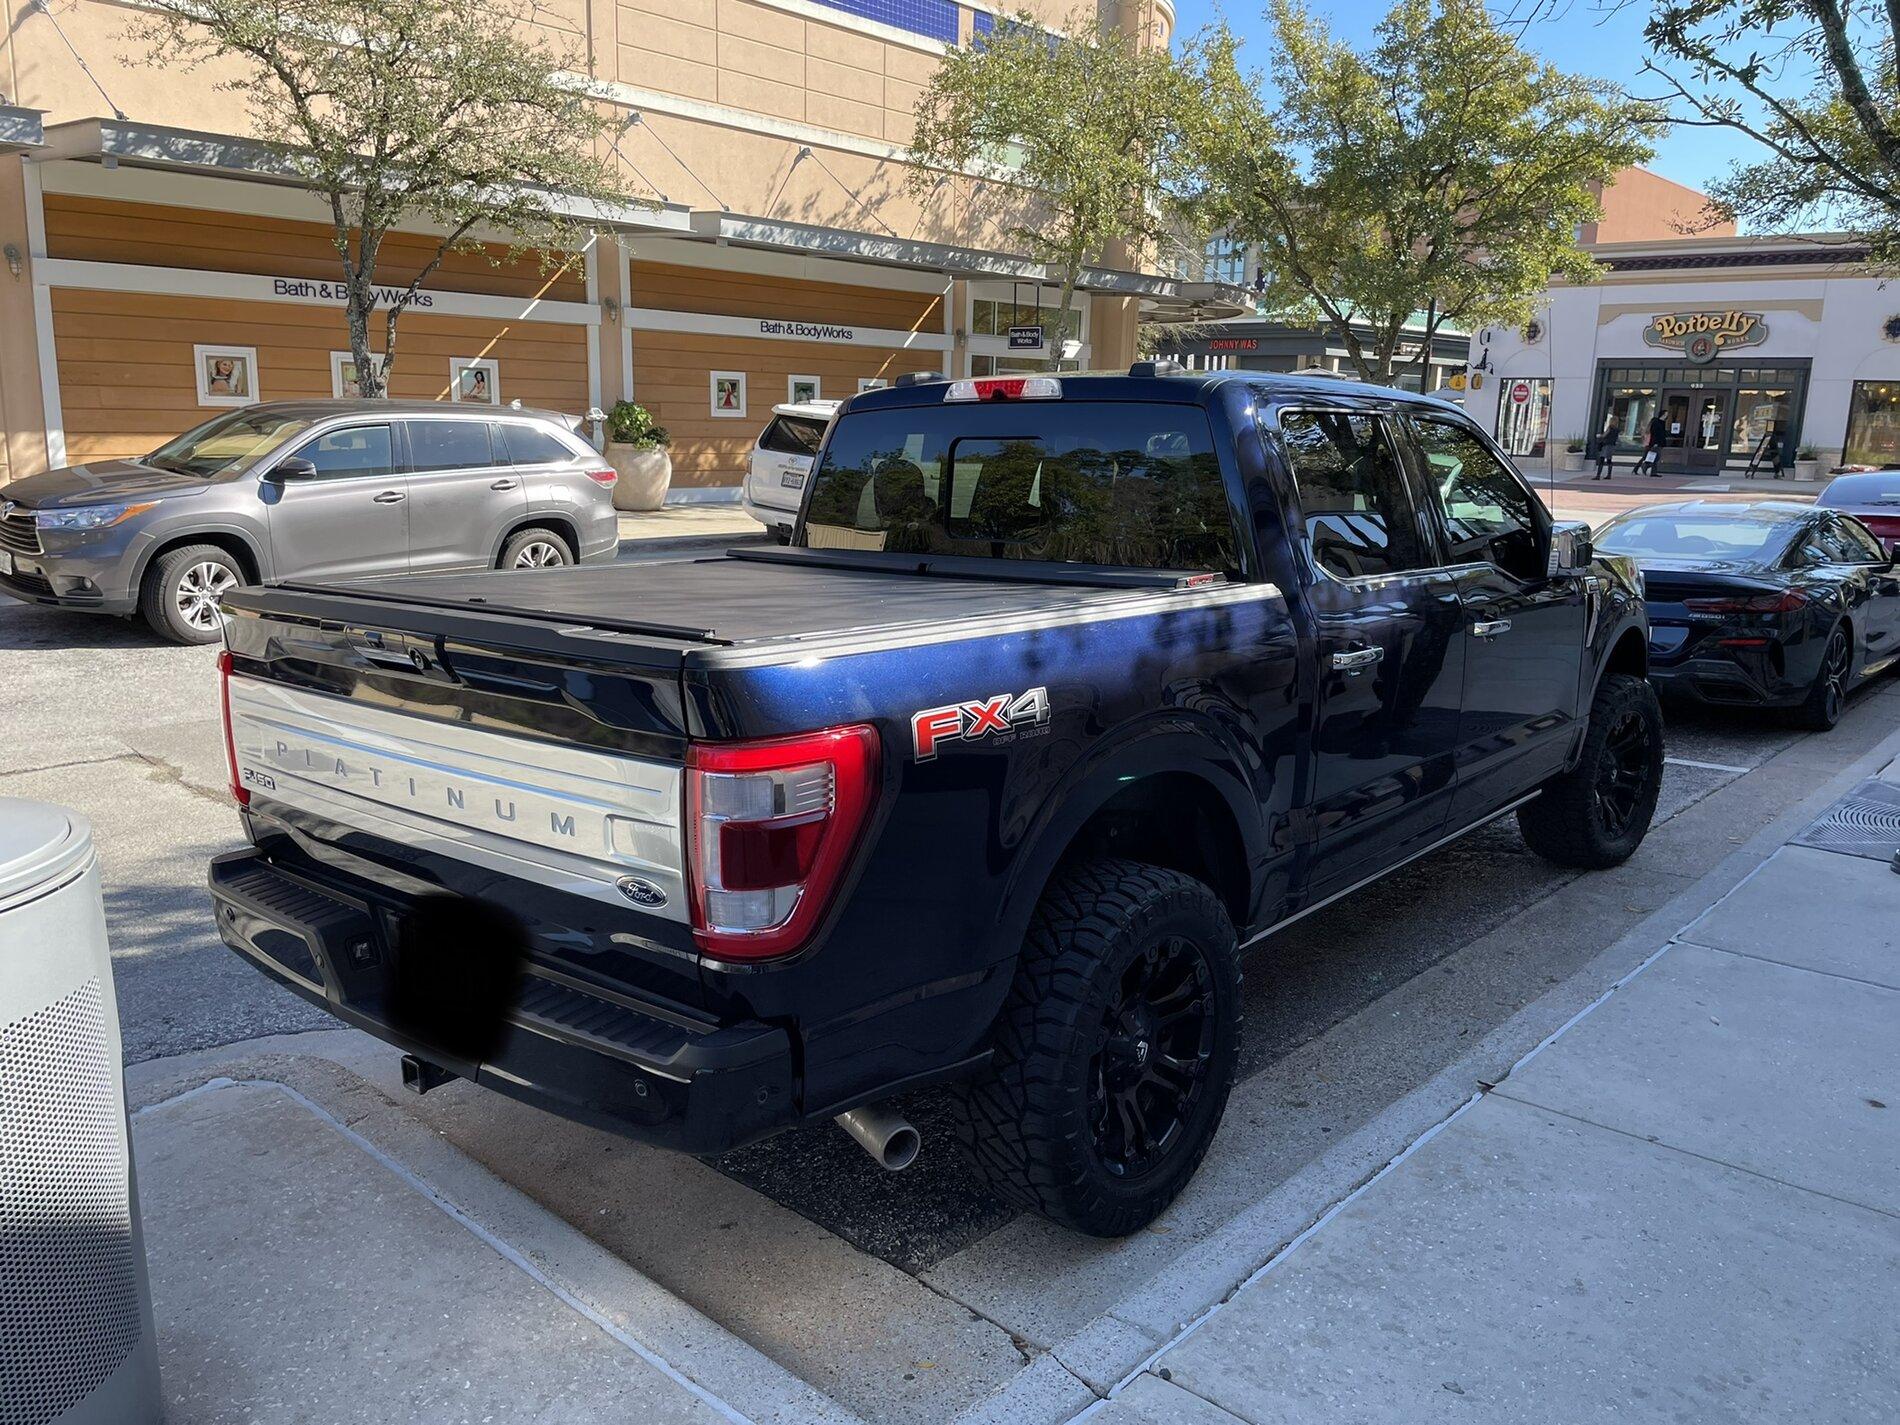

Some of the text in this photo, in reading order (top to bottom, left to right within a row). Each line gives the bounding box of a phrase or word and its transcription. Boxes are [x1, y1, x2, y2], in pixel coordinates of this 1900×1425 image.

[274, 279, 317, 298] Bath
[319, 283, 333, 299] &
[335, 284, 380, 302] By
[760, 321, 785, 334] Bath
[786, 323, 794, 335] &
[1655, 310, 1755, 345] Potbelly
[1208, 339, 1258, 350] JOHNNY WAS
[910, 686, 1052, 765] FX4
[276, 740, 576, 837] PLATINUM
[626, 881, 655, 903] Ford
